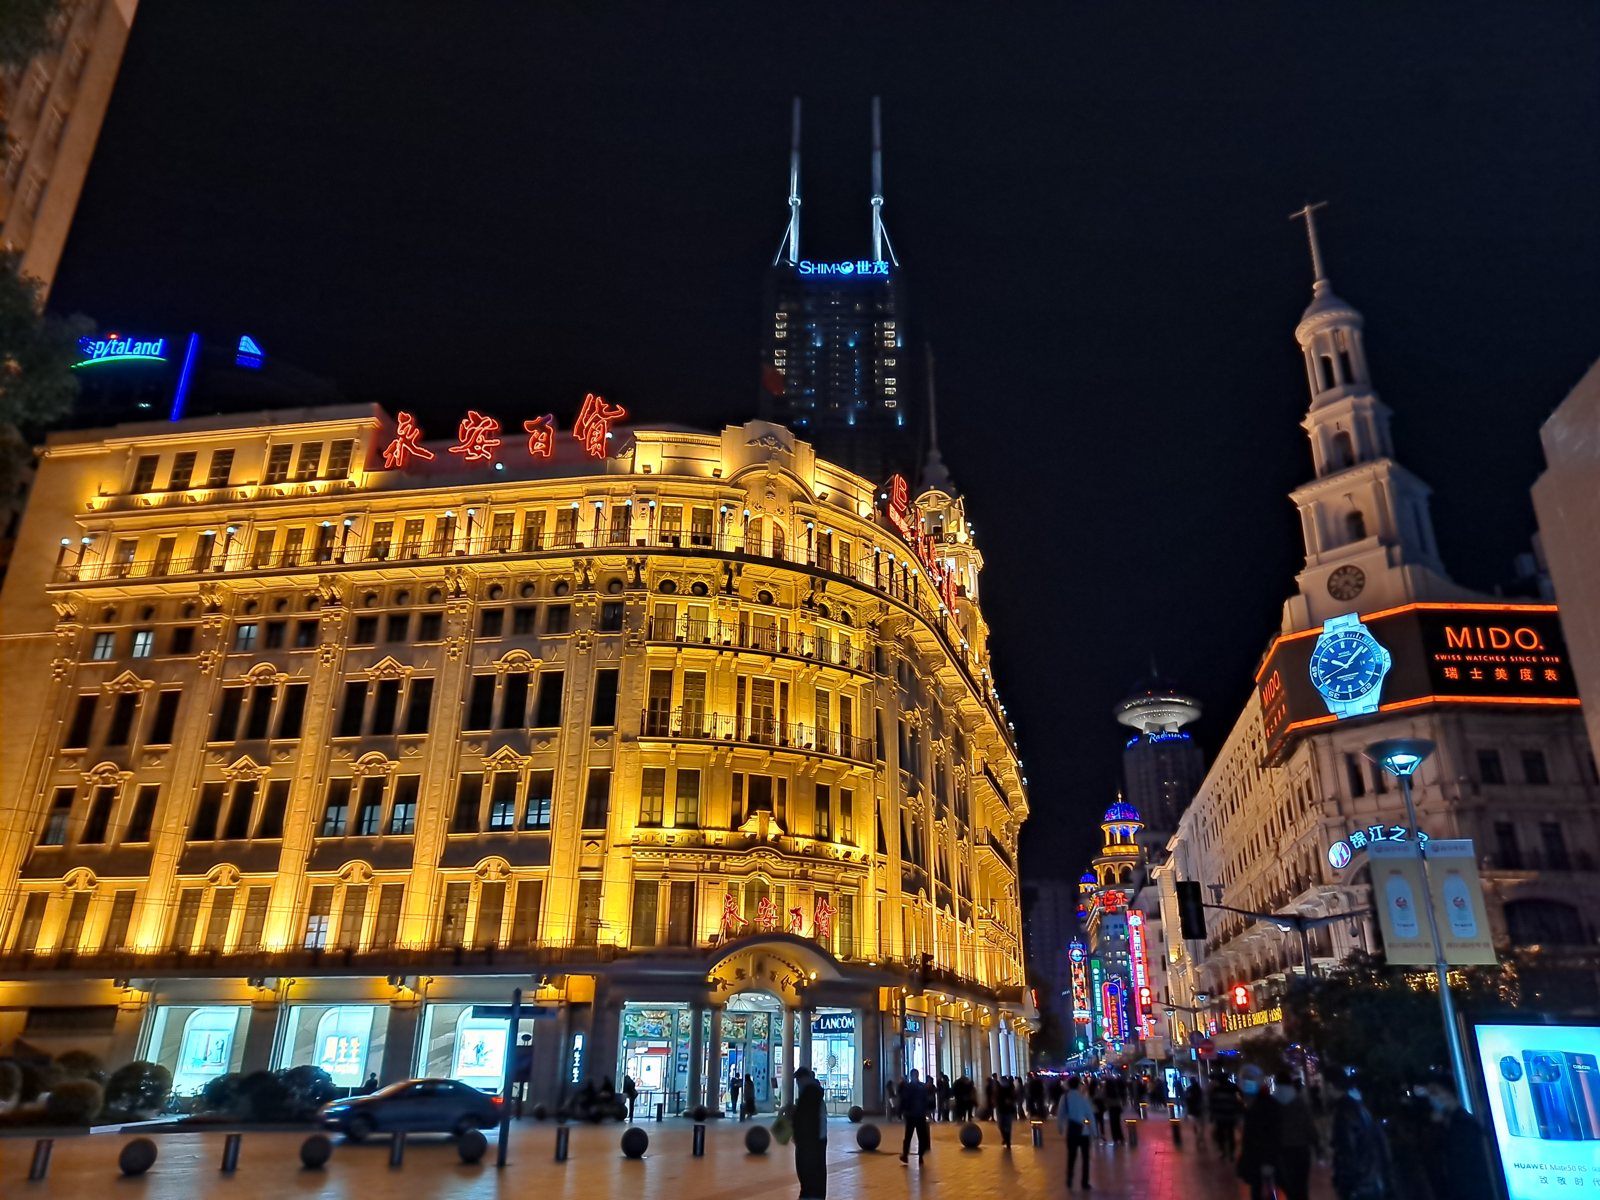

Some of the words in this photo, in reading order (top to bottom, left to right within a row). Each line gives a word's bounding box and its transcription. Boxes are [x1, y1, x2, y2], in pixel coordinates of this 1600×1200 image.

[856, 261, 889, 275] 世茂
[79, 337, 163, 359] pitaLand
[1509, 655, 1537, 663] SINCE
[1444, 666, 1558, 681] 瑞士美度表
[820, 1016, 855, 1030] LANCÔM
[1514, 1162, 1547, 1170] HUAWEI
